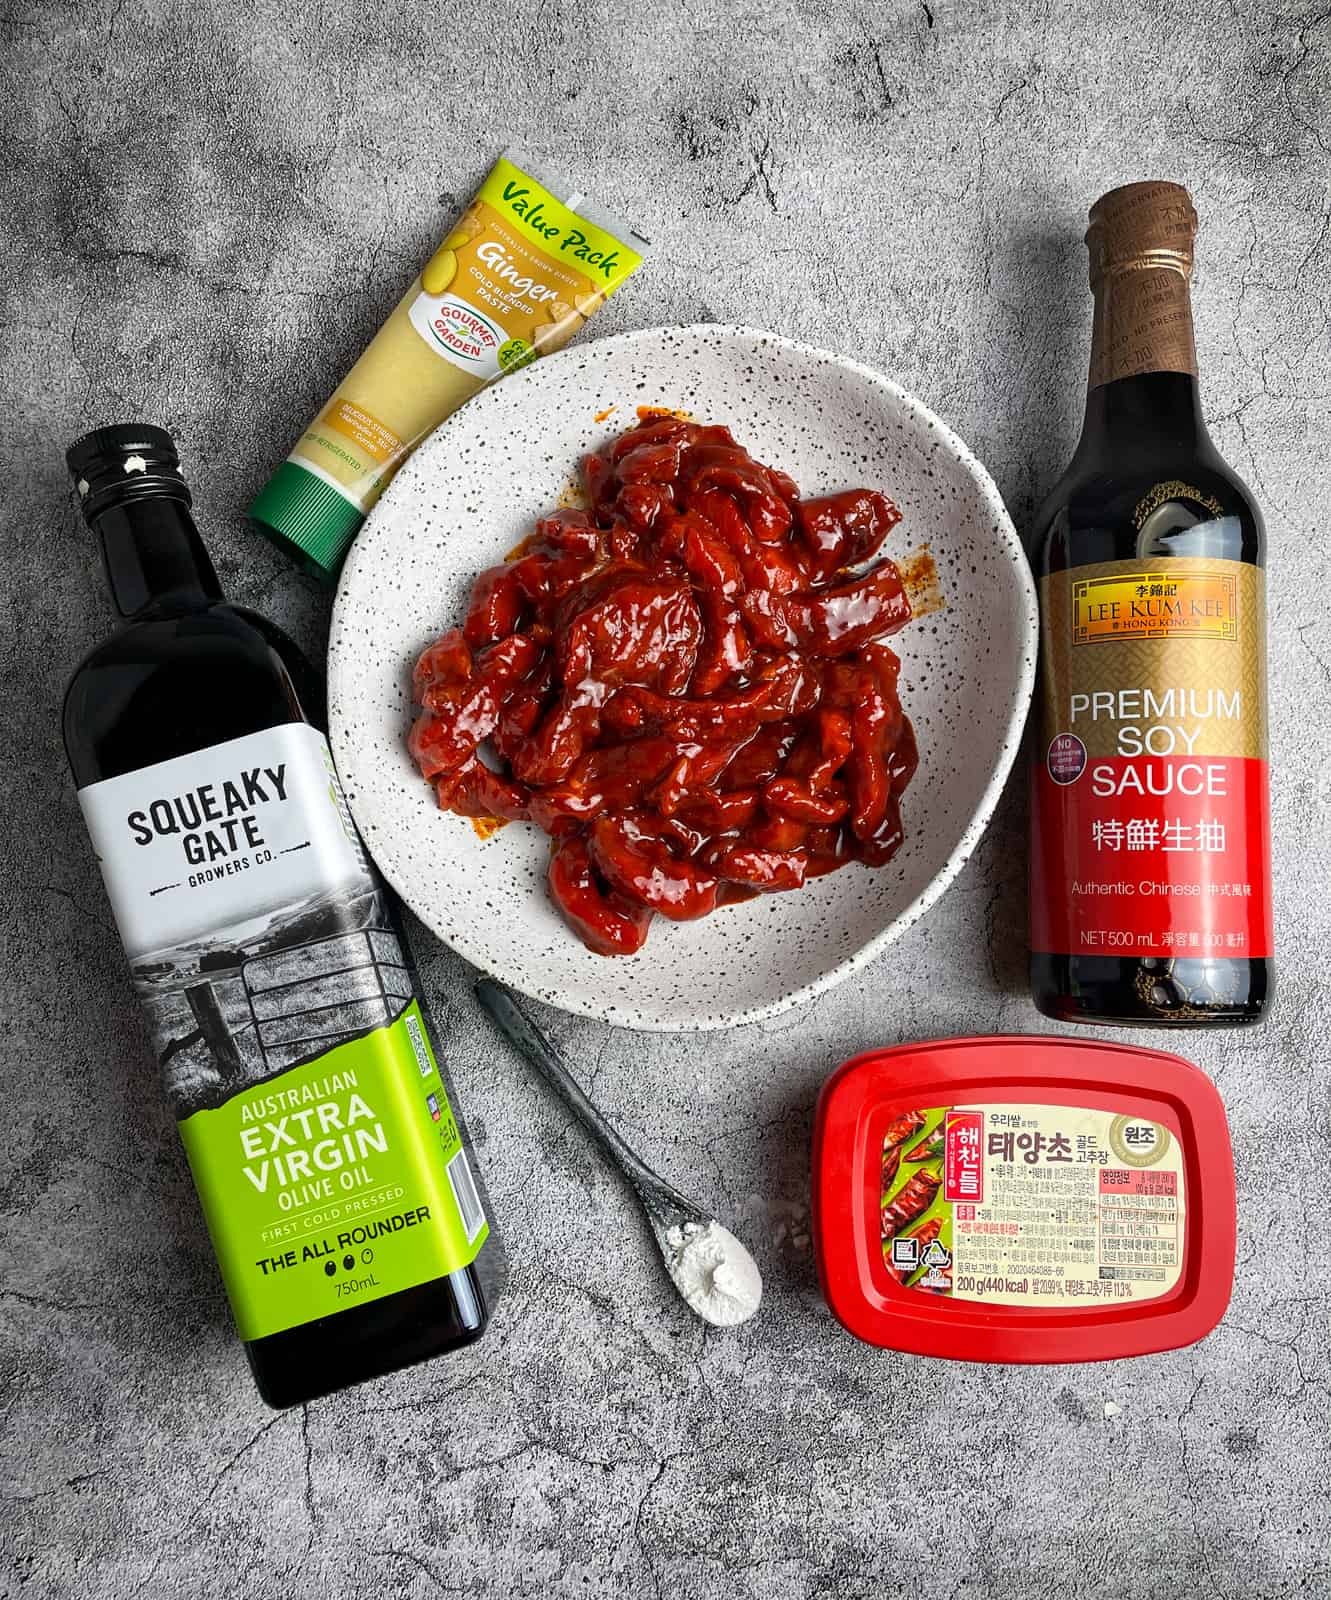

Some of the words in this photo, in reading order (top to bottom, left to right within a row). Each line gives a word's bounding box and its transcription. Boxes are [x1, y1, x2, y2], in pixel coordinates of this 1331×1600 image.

[503, 181, 559, 240] Value
[560, 229, 619, 278] Pack
[476, 241, 559, 303] Ginger
[468, 266, 493, 289] COLD
[494, 287, 534, 315] BLENDED
[476, 287, 512, 315] PASTE
[434, 319, 481, 356] GARDEN
[440, 306, 497, 347] GOURMET
[1136, 584, 1177, 598] 李錦記
[1088, 602, 1121, 622] LEE
[1128, 600, 1182, 618] KUM
[1190, 599, 1224, 617] KEE
[1123, 620, 1156, 629] HONG
[1160, 618, 1189, 627] KONG
[1070, 688, 1241, 723] PREMIUM
[1057, 738, 1072, 751] NO
[1117, 726, 1202, 757] SOY
[1091, 764, 1227, 796] SAUCE
[127, 764, 287, 846] SQUEAKY
[183, 815, 265, 865] GATE
[1092, 818, 1226, 852] 特鮮生抽
[188, 857, 250, 888] GROWERS
[255, 849, 278, 865] CO.
[1071, 881, 1135, 896] Authentic
[1139, 881, 1201, 896] Chinese
[240, 1069, 358, 1124] AUSTRALIAN
[240, 1093, 376, 1160] EXTRA
[1076, 1135, 1098, 1149] 골드
[1124, 1126, 1155, 1144] 원조
[242, 1123, 389, 1193] VIRGIN
[988, 1132, 1074, 1165] 태양초
[1076, 1150, 1110, 1165] 고추장
[278, 1177, 335, 1212] OLIVE
[340, 1165, 374, 1190] OIL
[261, 1222, 297, 1242] FIRST
[303, 1208, 340, 1229] COLD
[345, 1187, 405, 1213] PRESSED
[256, 1250, 298, 1275] THE
[302, 1239, 335, 1264] ALL
[338, 1206, 431, 1250] ROUNDER
[334, 1273, 381, 1298] 750mL
[957, 1276, 975, 1291] 200
